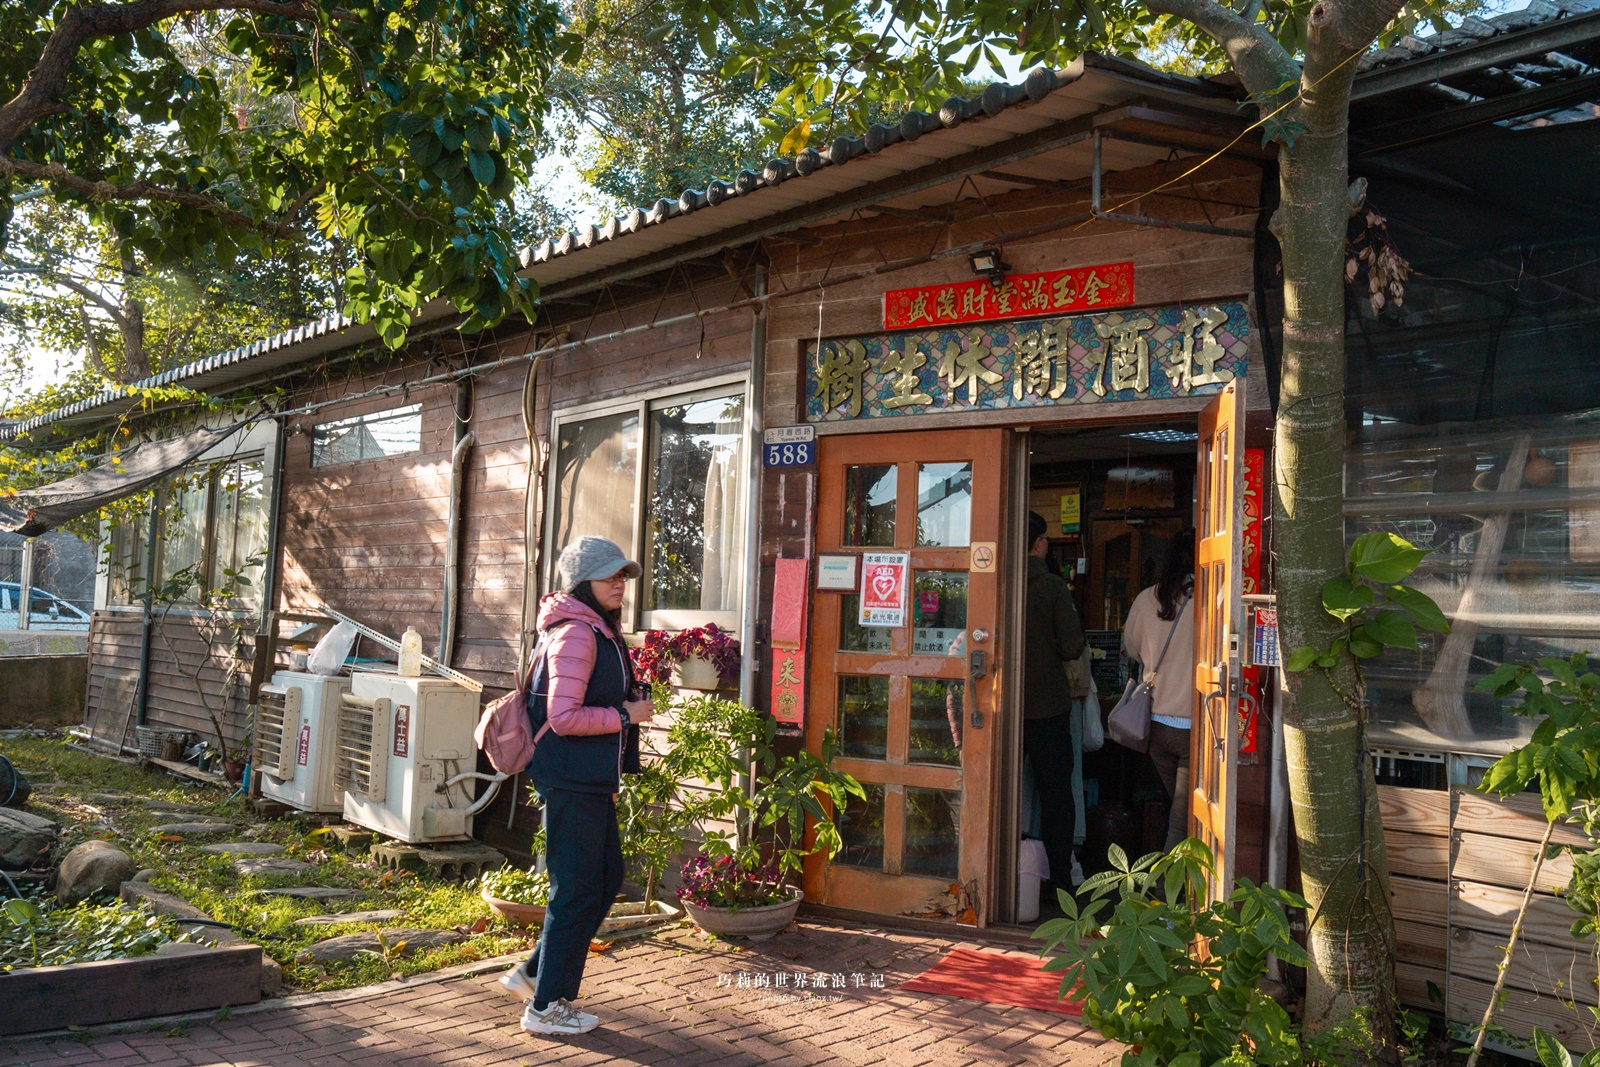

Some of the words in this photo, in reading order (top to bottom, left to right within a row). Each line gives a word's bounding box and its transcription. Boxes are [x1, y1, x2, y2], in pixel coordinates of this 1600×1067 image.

[777, 427, 811, 437] 月眉西路
[769, 443, 808, 465] 588
[866, 556, 904, 564] 本場所設置
[876, 567, 894, 576] AED
[869, 641, 892, 650] 未滿十
[914, 642, 944, 652] 禁止飲酒
[396, 707, 407, 753] 萬士益
[299, 729, 308, 764] 萬士益
